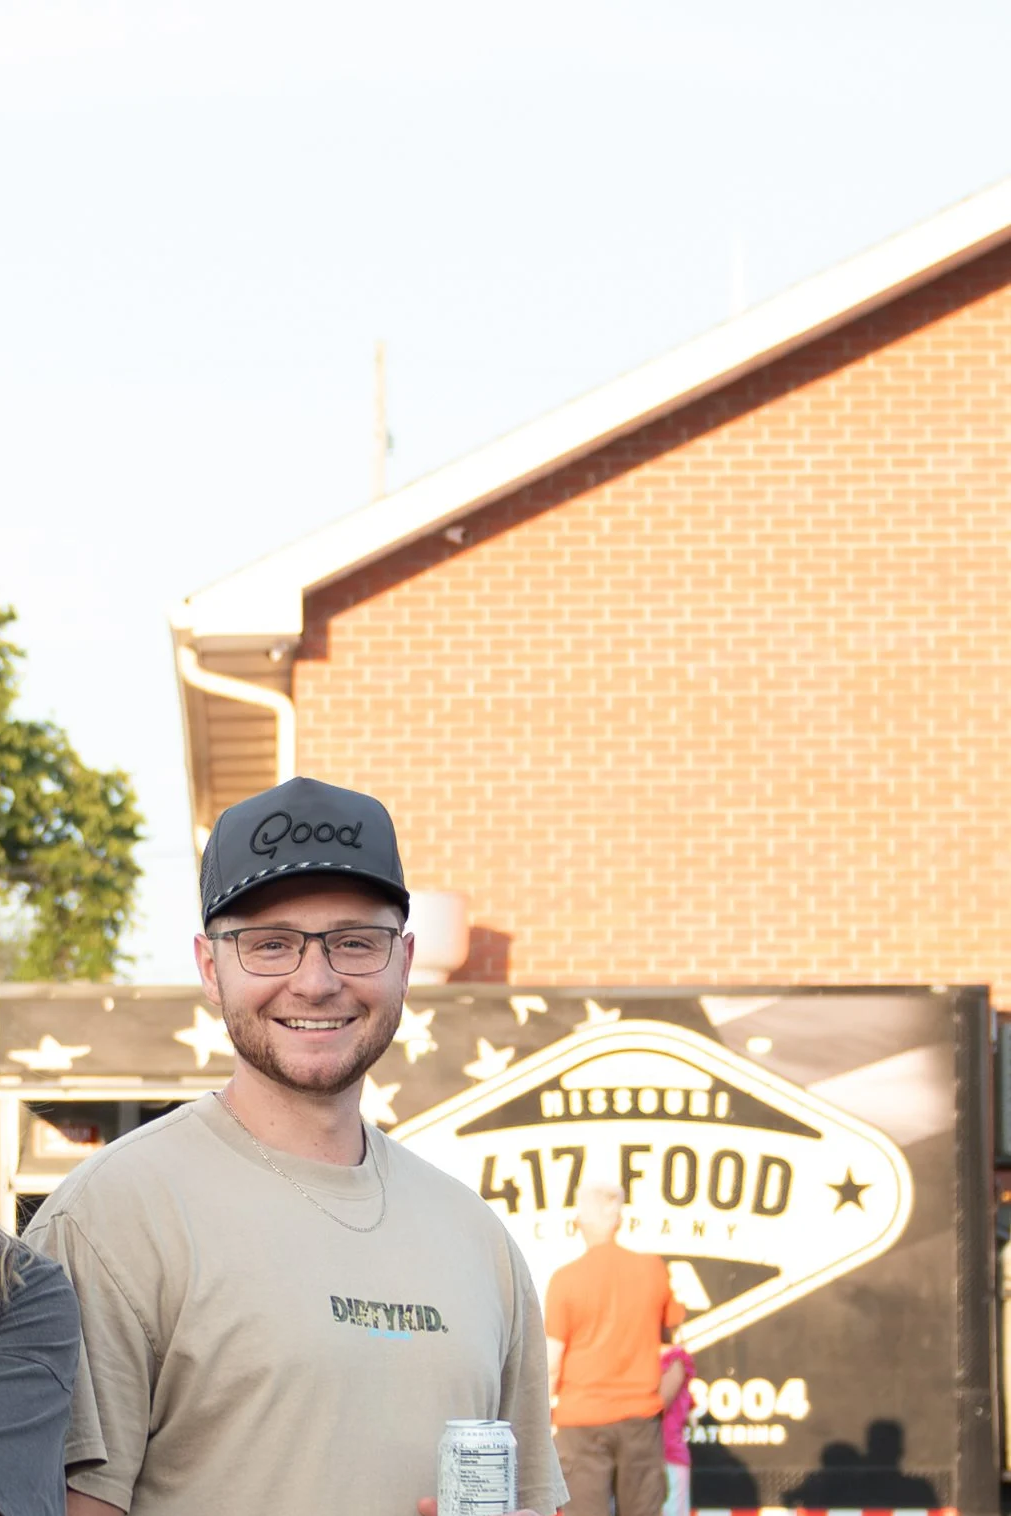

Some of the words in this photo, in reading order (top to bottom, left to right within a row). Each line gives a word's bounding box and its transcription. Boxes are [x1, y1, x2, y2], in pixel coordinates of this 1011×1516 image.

[249, 809, 363, 860] Good
[479, 1145, 587, 1215] 417
[619, 1143, 794, 1218] FOOD
[534, 1216, 738, 1241] COPANY
